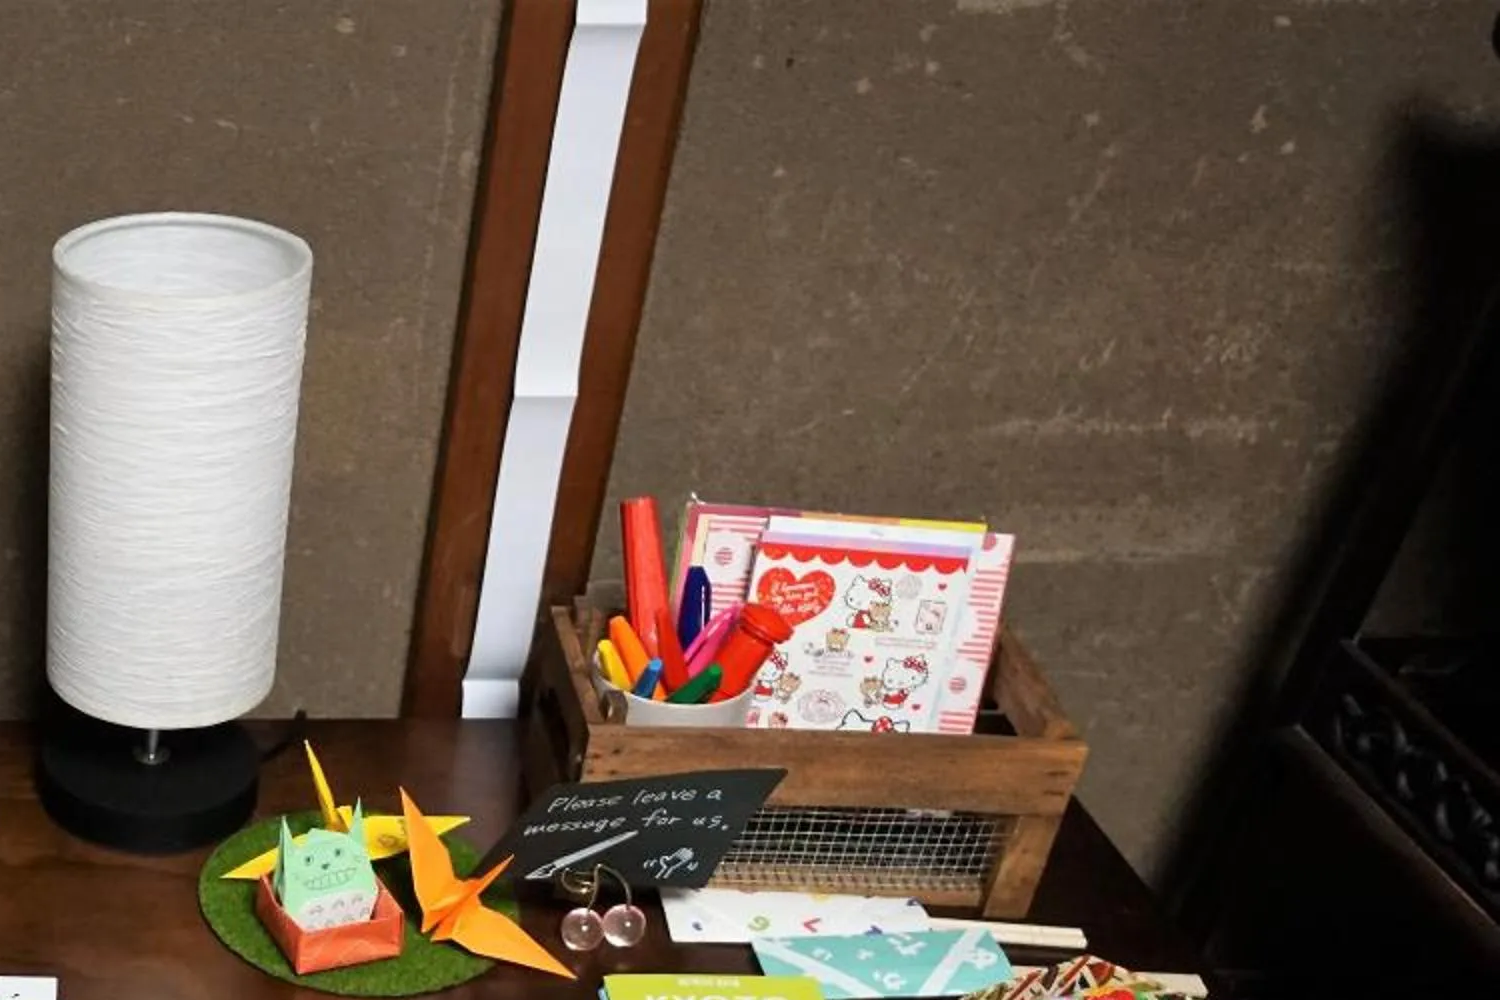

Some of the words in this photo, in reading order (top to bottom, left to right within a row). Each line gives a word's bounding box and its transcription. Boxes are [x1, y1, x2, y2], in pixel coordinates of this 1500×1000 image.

[547, 795, 623, 813] Please
[632, 788, 697, 806] leave
[706, 788, 723, 801] a
[523, 816, 627, 837] message
[641, 807, 683, 829] for
